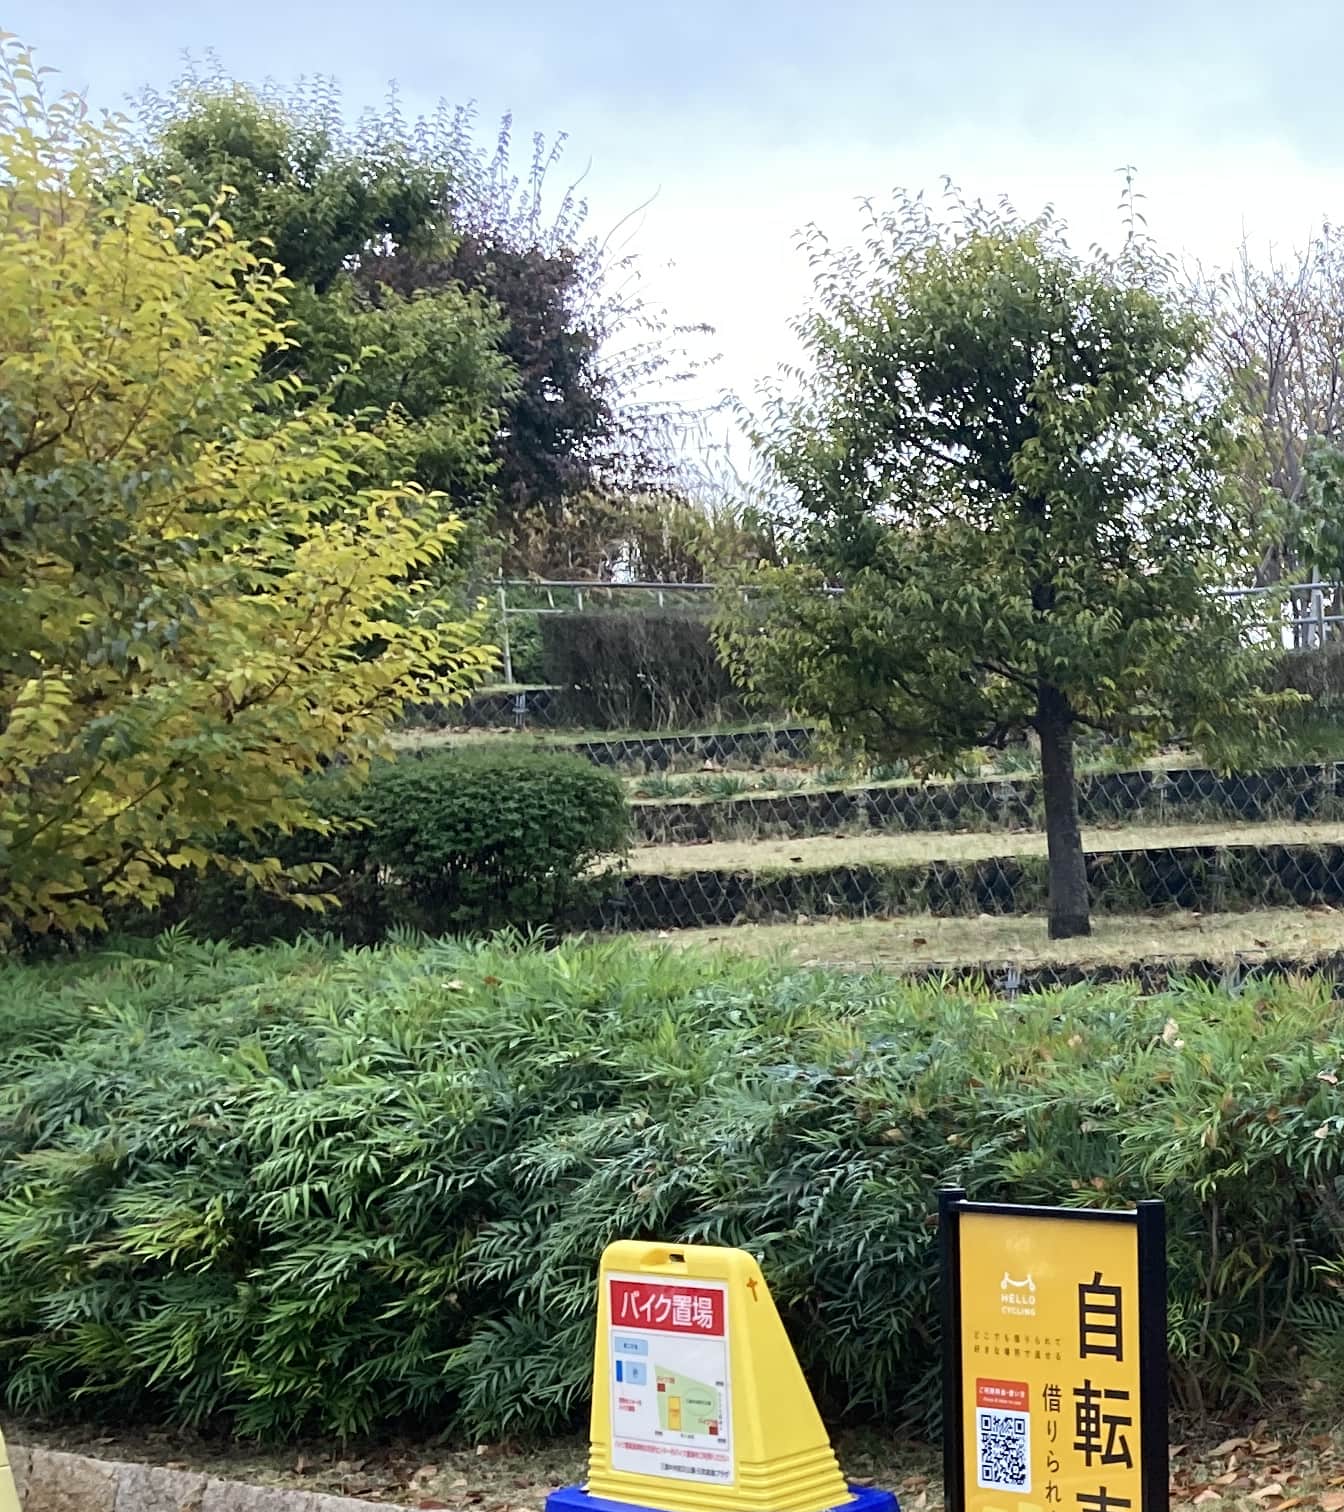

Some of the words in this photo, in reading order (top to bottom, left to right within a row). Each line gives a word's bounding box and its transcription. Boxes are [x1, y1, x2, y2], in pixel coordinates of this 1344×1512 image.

[620, 1290, 715, 1330] バイク置場
[1001, 1293, 1036, 1306] HELLO
